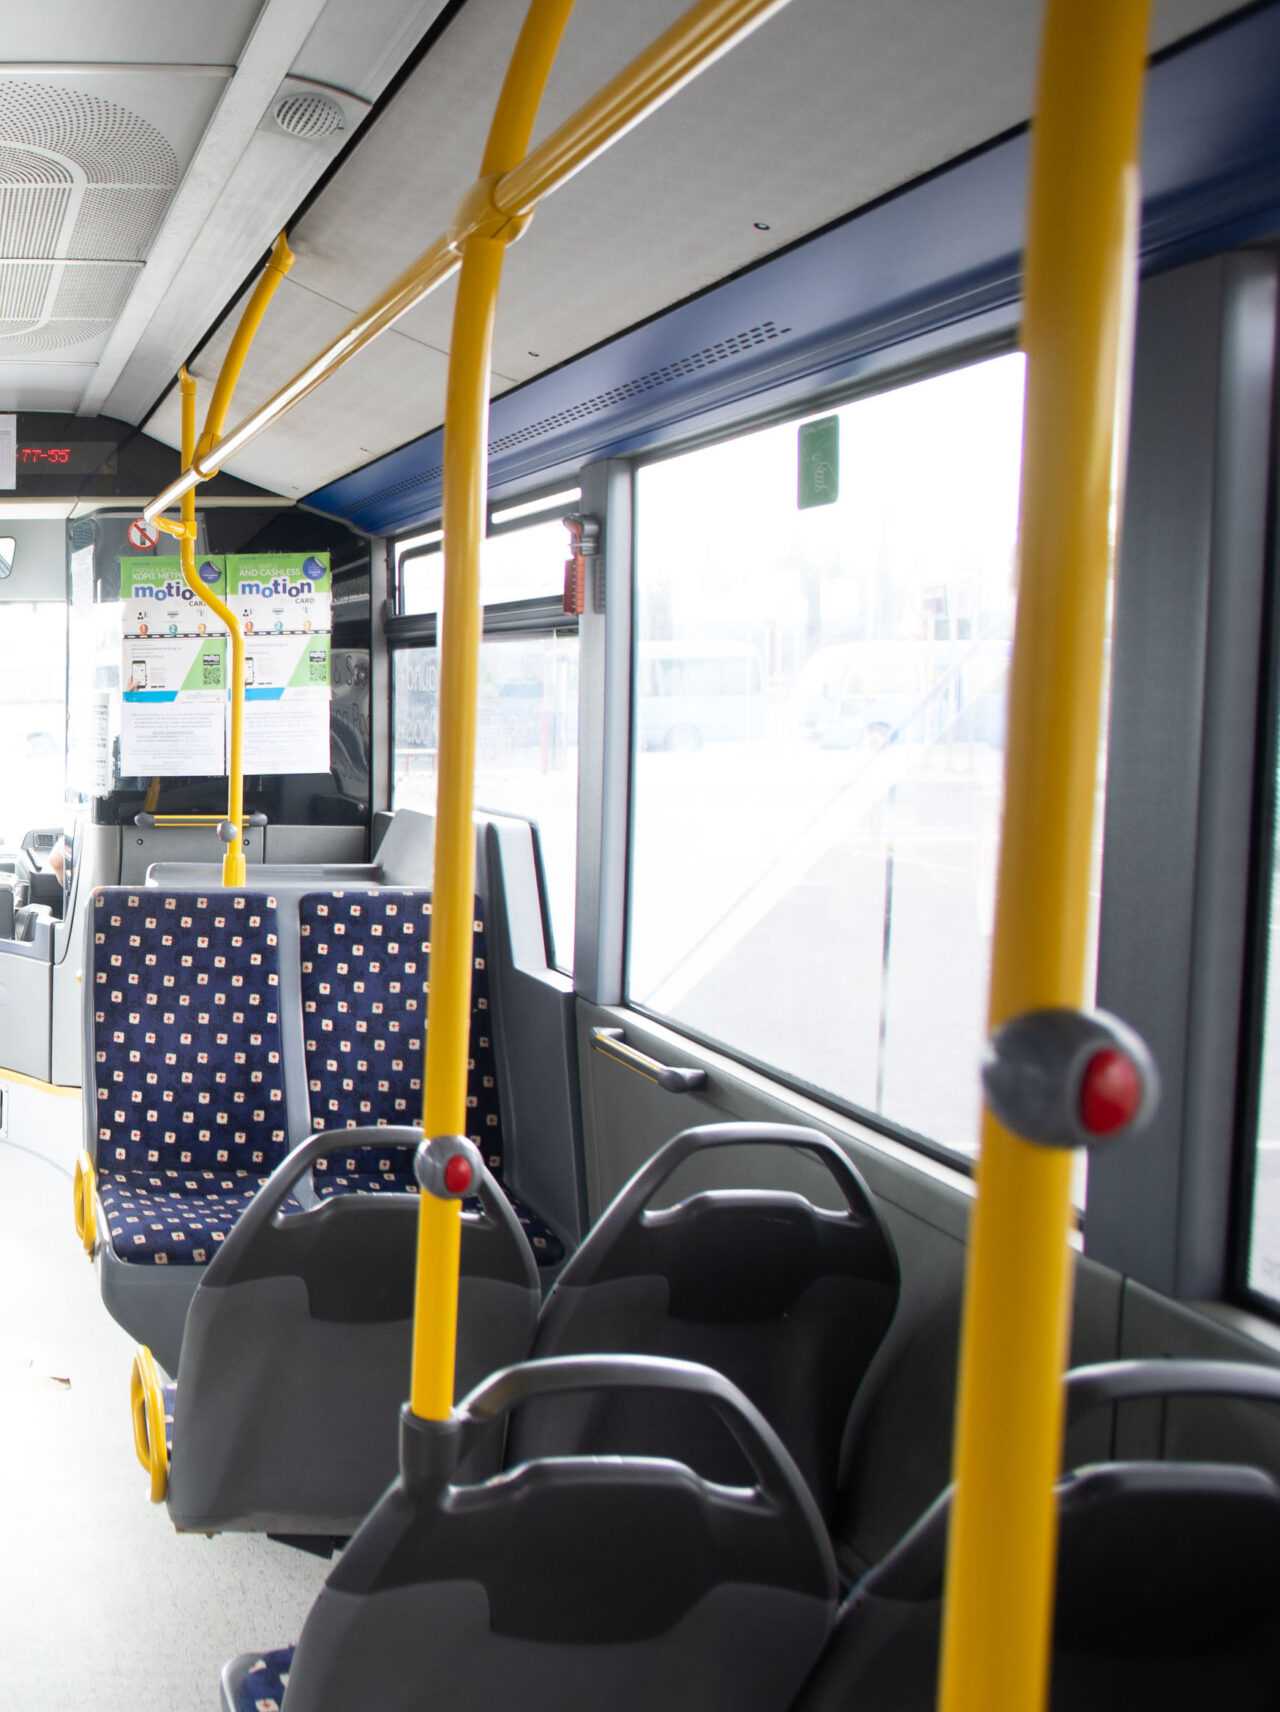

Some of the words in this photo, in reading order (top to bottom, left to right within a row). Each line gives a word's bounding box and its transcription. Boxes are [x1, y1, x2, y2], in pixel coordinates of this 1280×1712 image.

[239, 568, 259, 578] AND
[259, 567, 302, 577] CASHLESS
[134, 581, 197, 601] motio
[240, 578, 312, 598] motion
